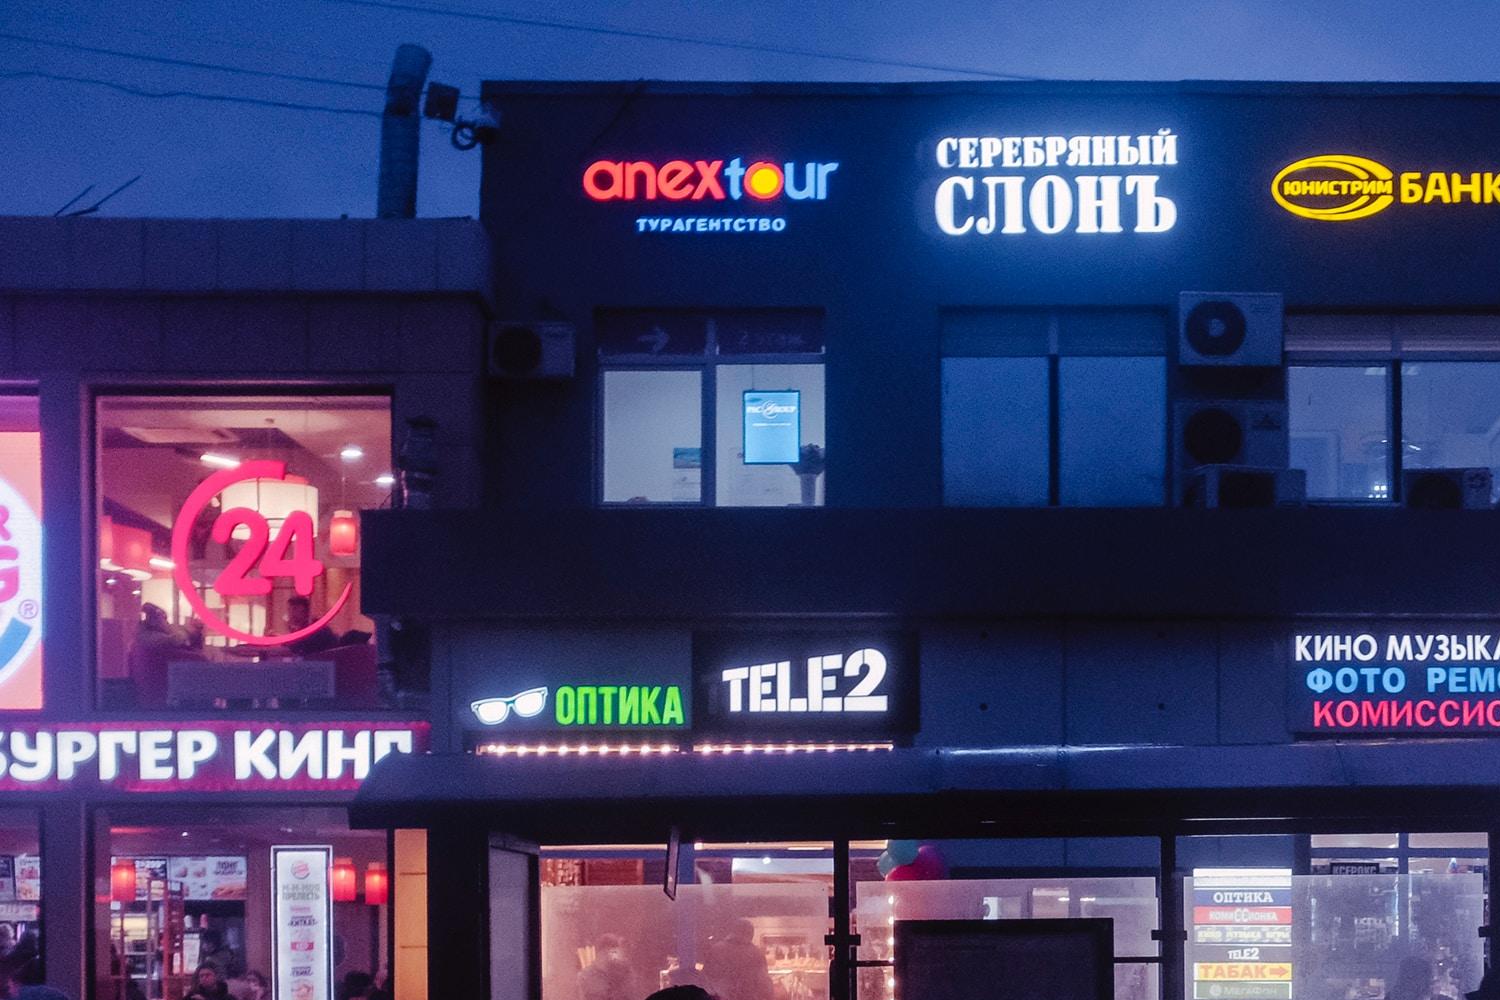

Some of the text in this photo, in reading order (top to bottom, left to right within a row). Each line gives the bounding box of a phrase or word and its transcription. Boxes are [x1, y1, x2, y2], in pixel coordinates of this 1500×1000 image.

[935, 127, 1179, 169] СЕРЕБРЯНЫЙ
[1282, 181, 1393, 197] ЮНИСТРИМ
[934, 174, 1179, 237] СЛОНЪ
[635, 216, 787, 233] ТУРАГЕНТСТВО
[211, 505, 325, 598] 24
[1295, 634, 1379, 661] КИНО
[721, 648, 889, 713] TELE2
[1306, 666, 1403, 694] ФОТО
[555, 685, 685, 726] ОПТИКА
[0, 729, 218, 782] УРГЕР
[1212, 891, 1275, 904] ОПТИКА
[1227, 947, 1260, 960] TELE2
[1200, 964, 1267, 979] ТАБАК
